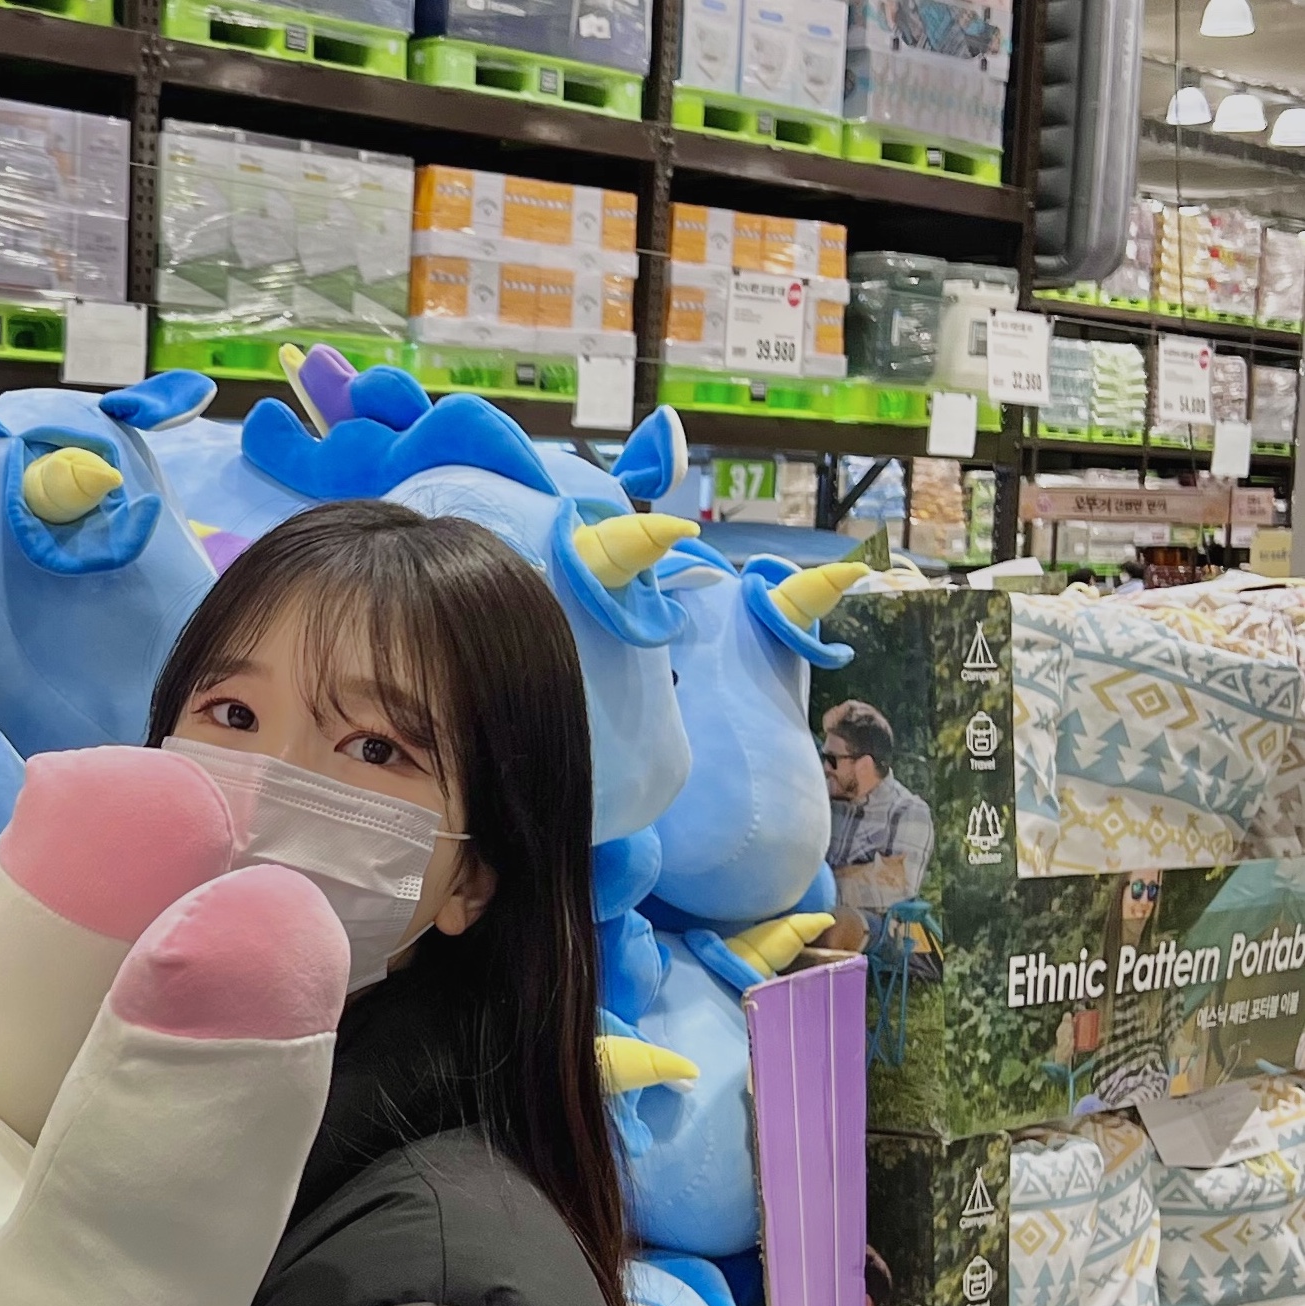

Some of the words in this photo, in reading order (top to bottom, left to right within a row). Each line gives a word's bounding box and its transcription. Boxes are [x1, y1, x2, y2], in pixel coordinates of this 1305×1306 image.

[756, 339, 795, 363] 39,980
[729, 464, 764, 500] 37
[970, 757, 996, 770] Travel
[1008, 947, 1108, 1008] Ethnic
[1115, 940, 1221, 995] Pattern
[1227, 922, 1305, 980] Portab
[1197, 1002, 1228, 1031] 에스닉
[1281, 989, 1300, 1017] 이불
